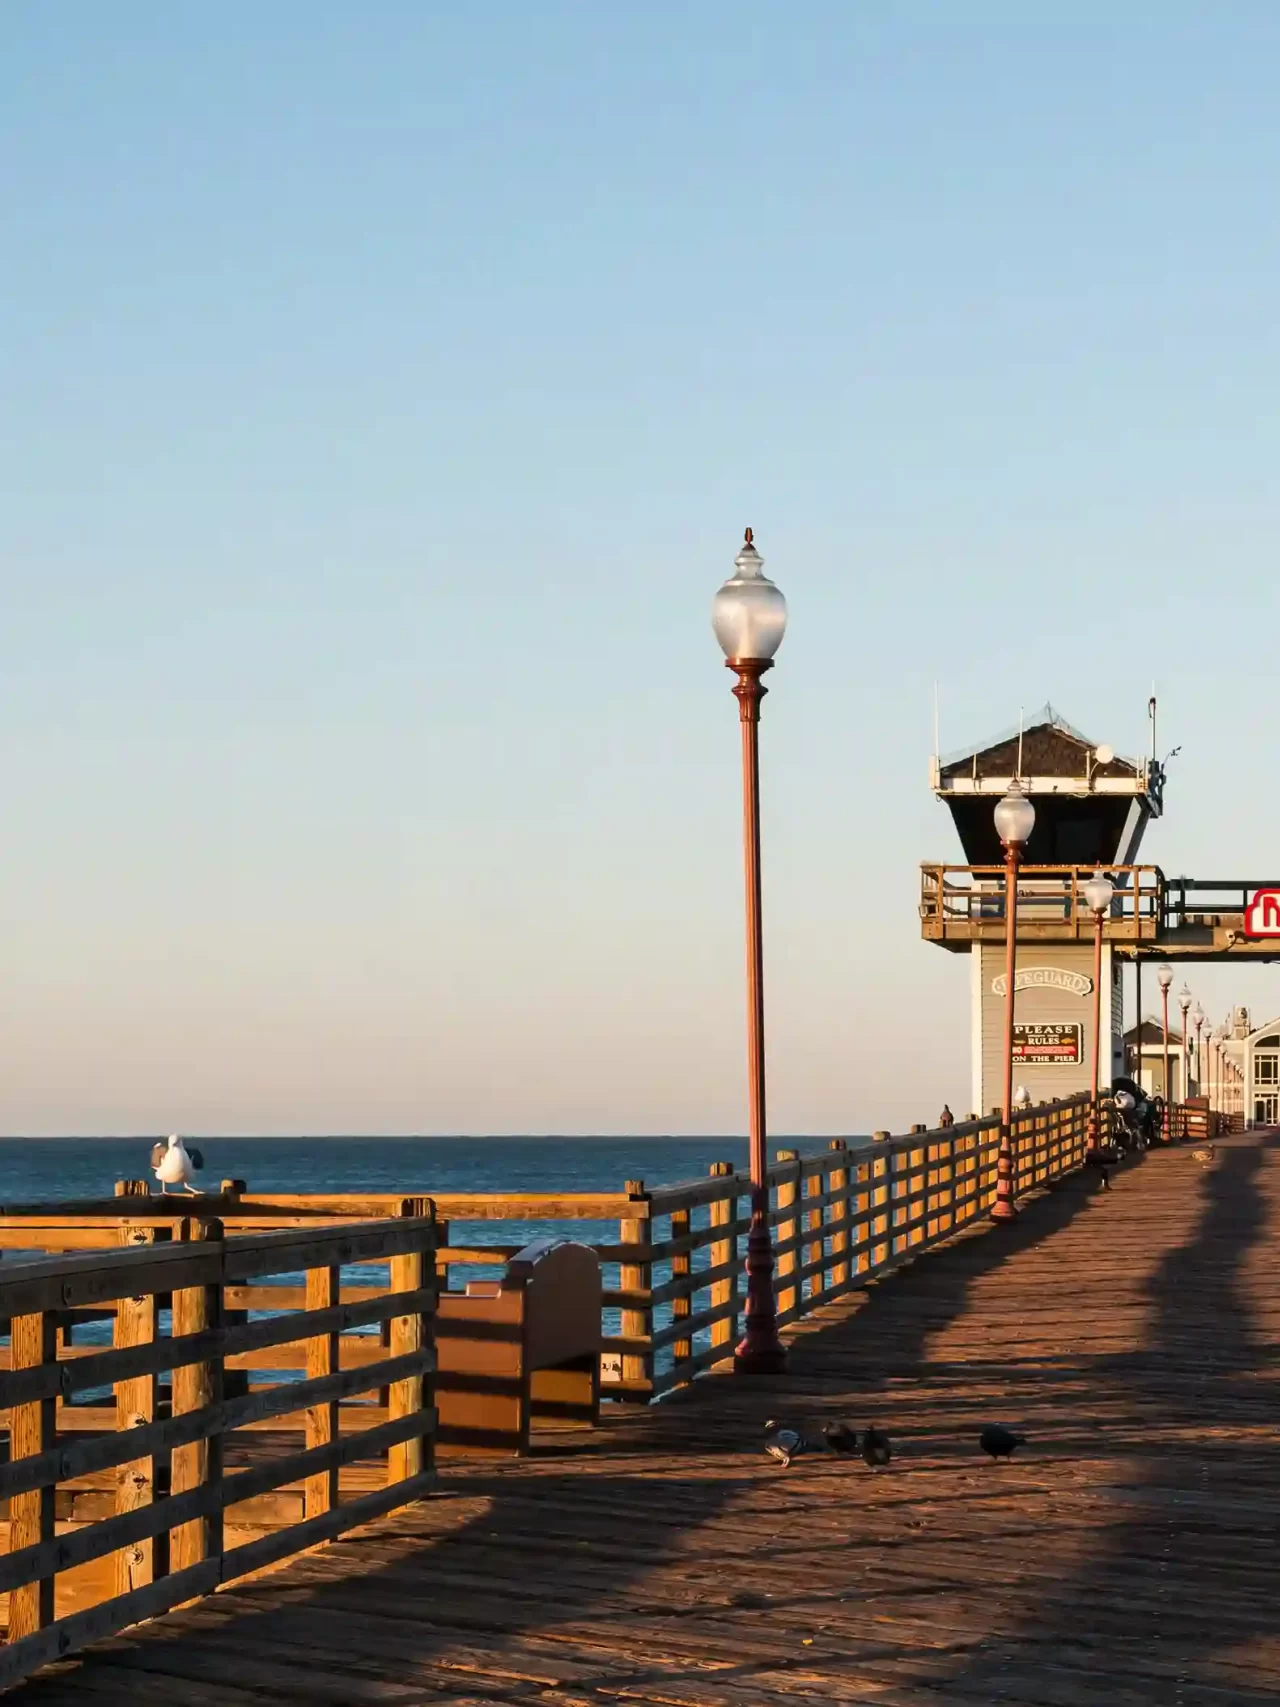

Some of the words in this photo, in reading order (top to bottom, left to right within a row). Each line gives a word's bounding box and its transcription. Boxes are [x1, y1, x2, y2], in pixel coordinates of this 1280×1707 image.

[1000, 971, 1084, 990] LFEGUARD
[1014, 1025, 1073, 1034] PLEASE
[1027, 1037, 1060, 1046] RULES
